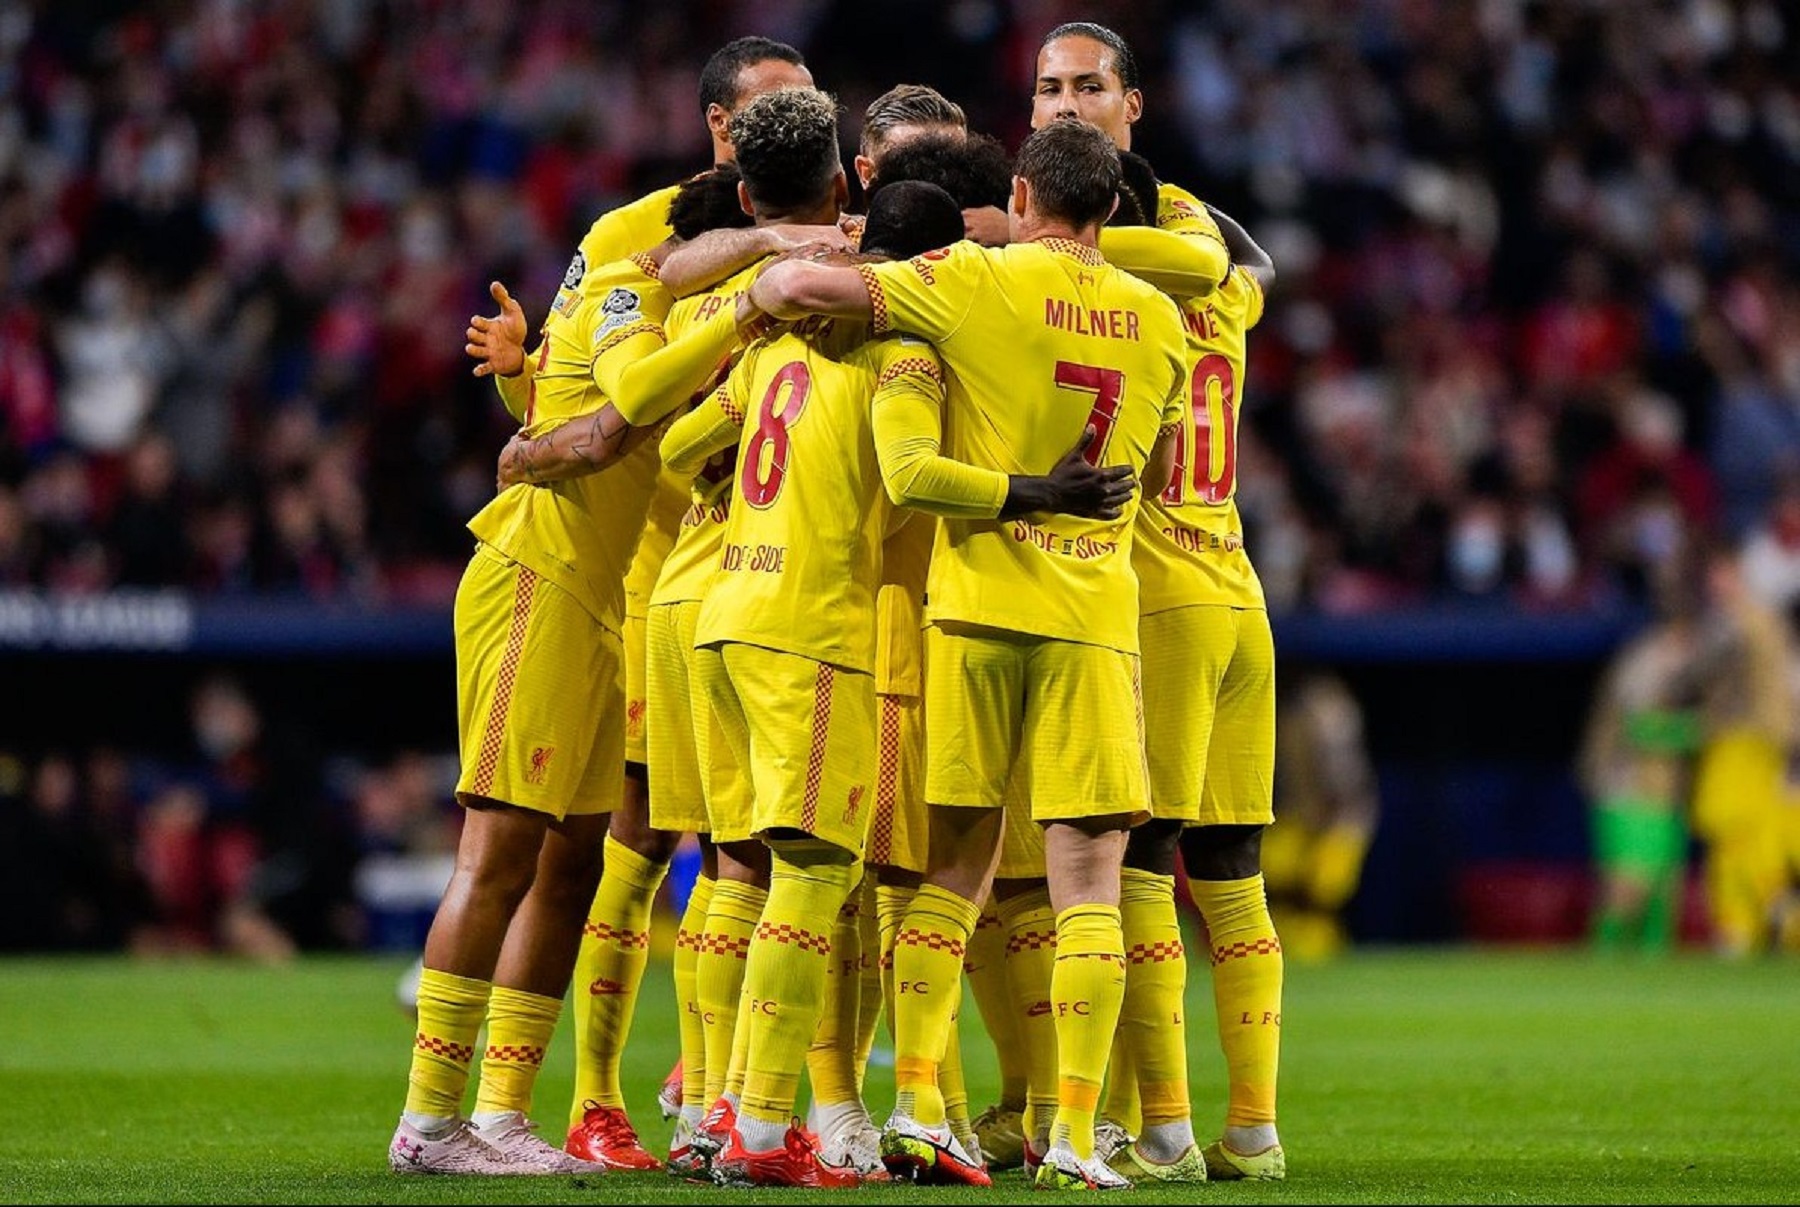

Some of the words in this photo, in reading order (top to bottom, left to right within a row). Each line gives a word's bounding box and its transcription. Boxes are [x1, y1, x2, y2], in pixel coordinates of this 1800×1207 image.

[1045, 297, 1140, 342] MILNER
[742, 361, 812, 511] 8
[1054, 360, 1127, 469] 7
[750, 544, 788, 573] SIDE
